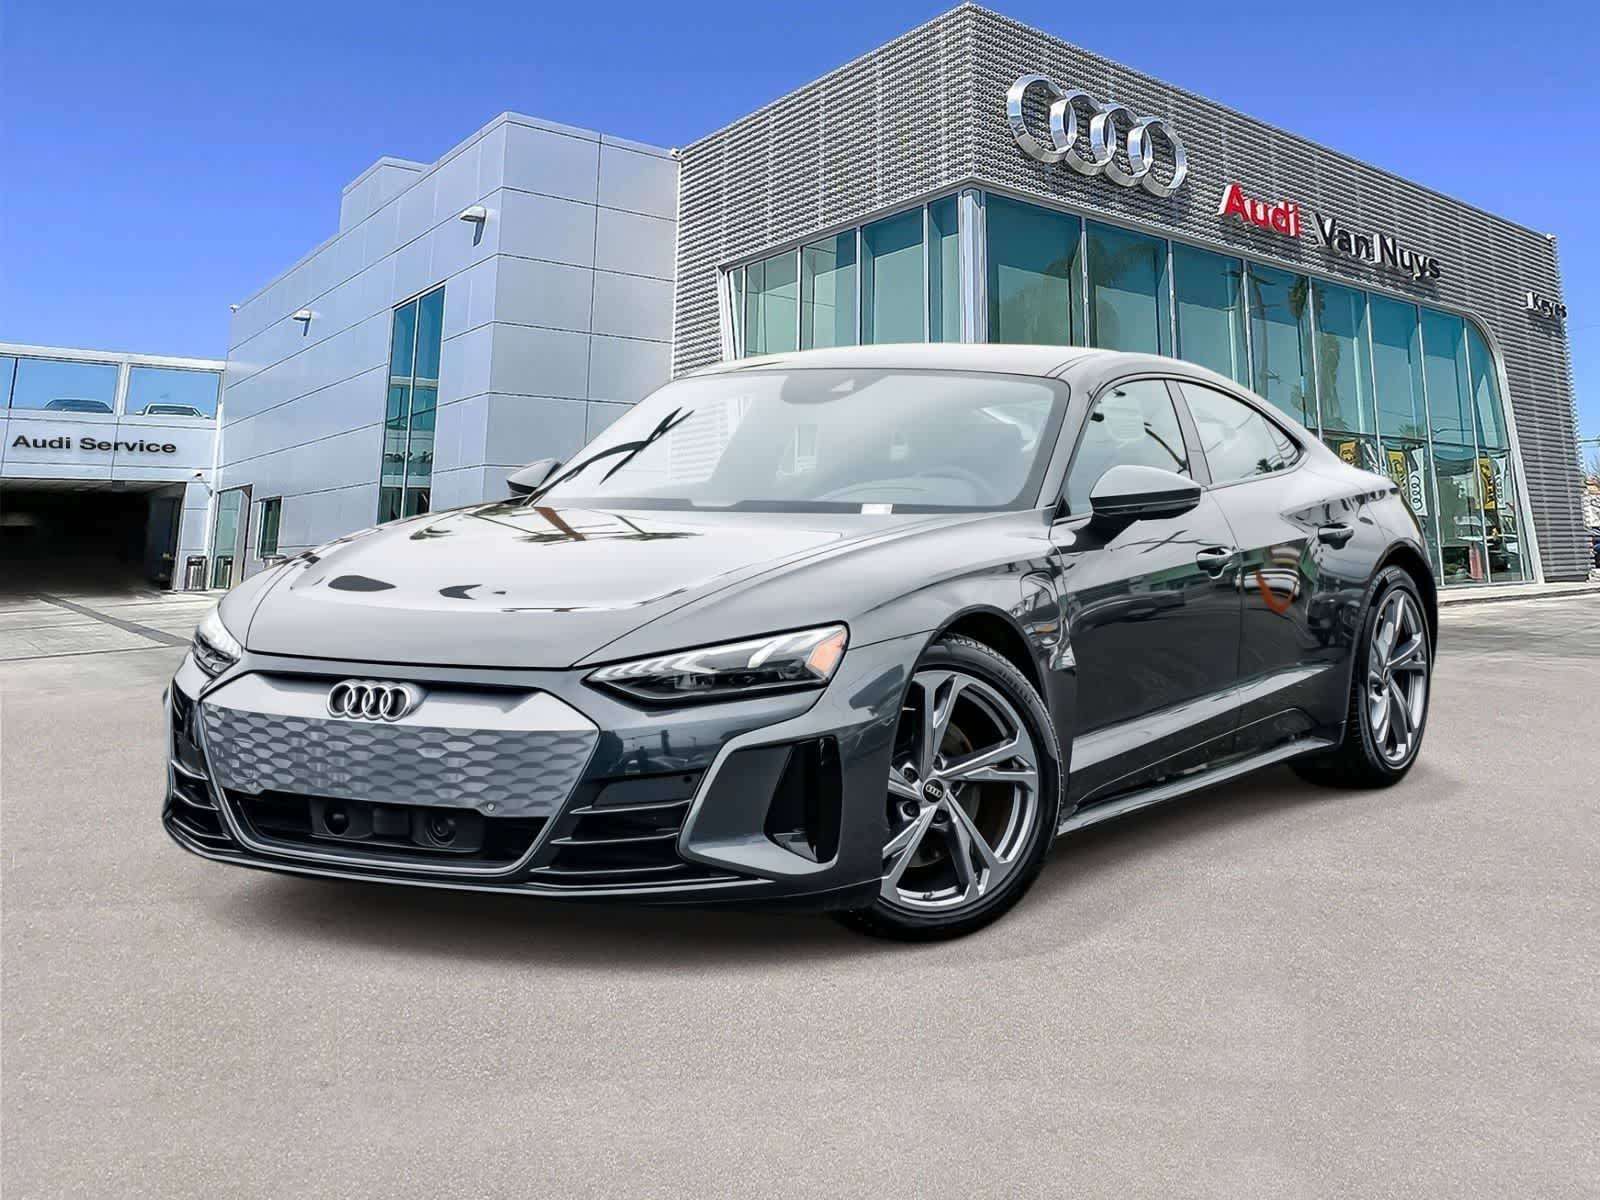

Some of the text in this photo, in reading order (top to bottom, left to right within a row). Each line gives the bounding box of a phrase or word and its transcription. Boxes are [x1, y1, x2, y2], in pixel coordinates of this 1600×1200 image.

[1217, 183, 1442, 280] Audi Van Nuys
[1526, 292, 1567, 318] Keyes
[12, 434, 177, 453] Audi Service
